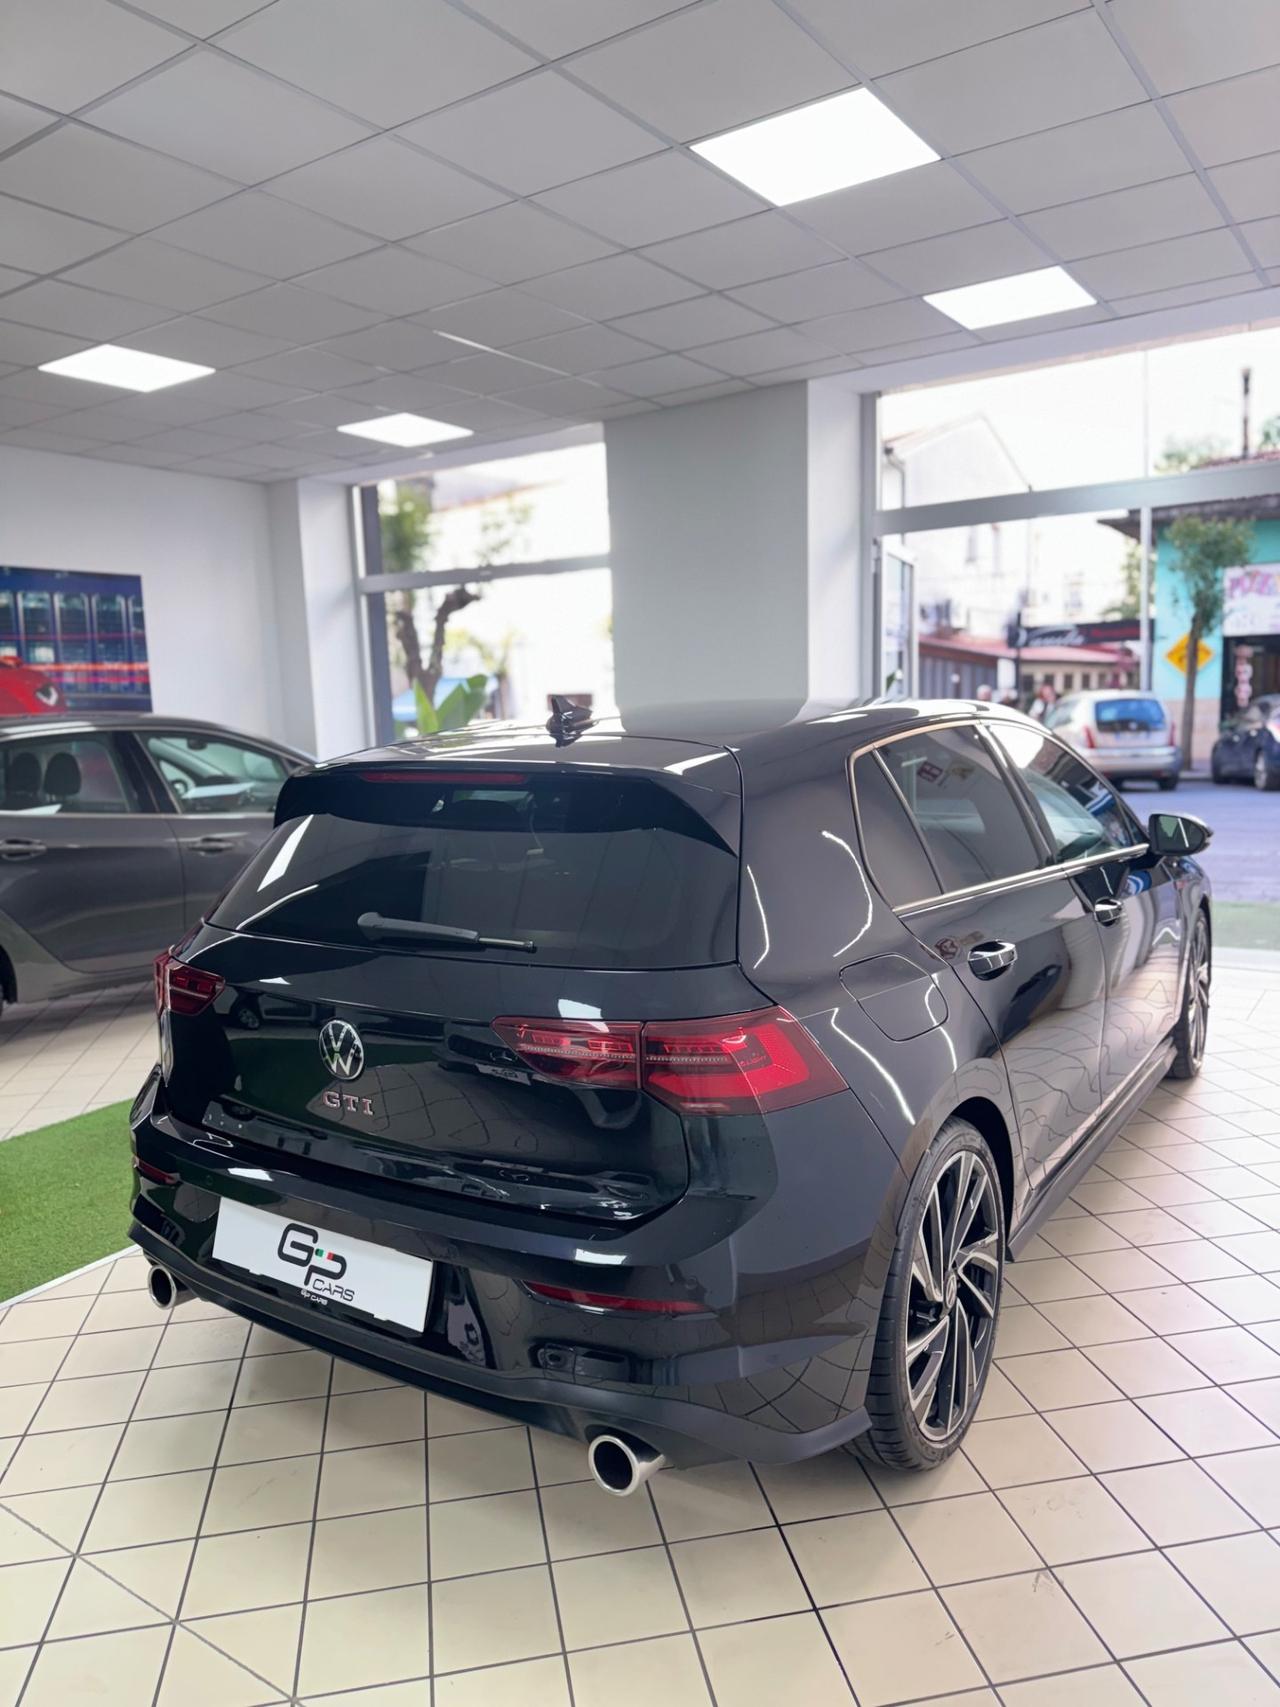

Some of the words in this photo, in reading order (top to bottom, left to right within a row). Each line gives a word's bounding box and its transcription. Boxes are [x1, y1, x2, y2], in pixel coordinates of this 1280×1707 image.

[319, 1020, 364, 1080] VW
[323, 1091, 373, 1116] GTI
[278, 1223, 347, 1286] GP
[312, 1278, 355, 1302] CARS
